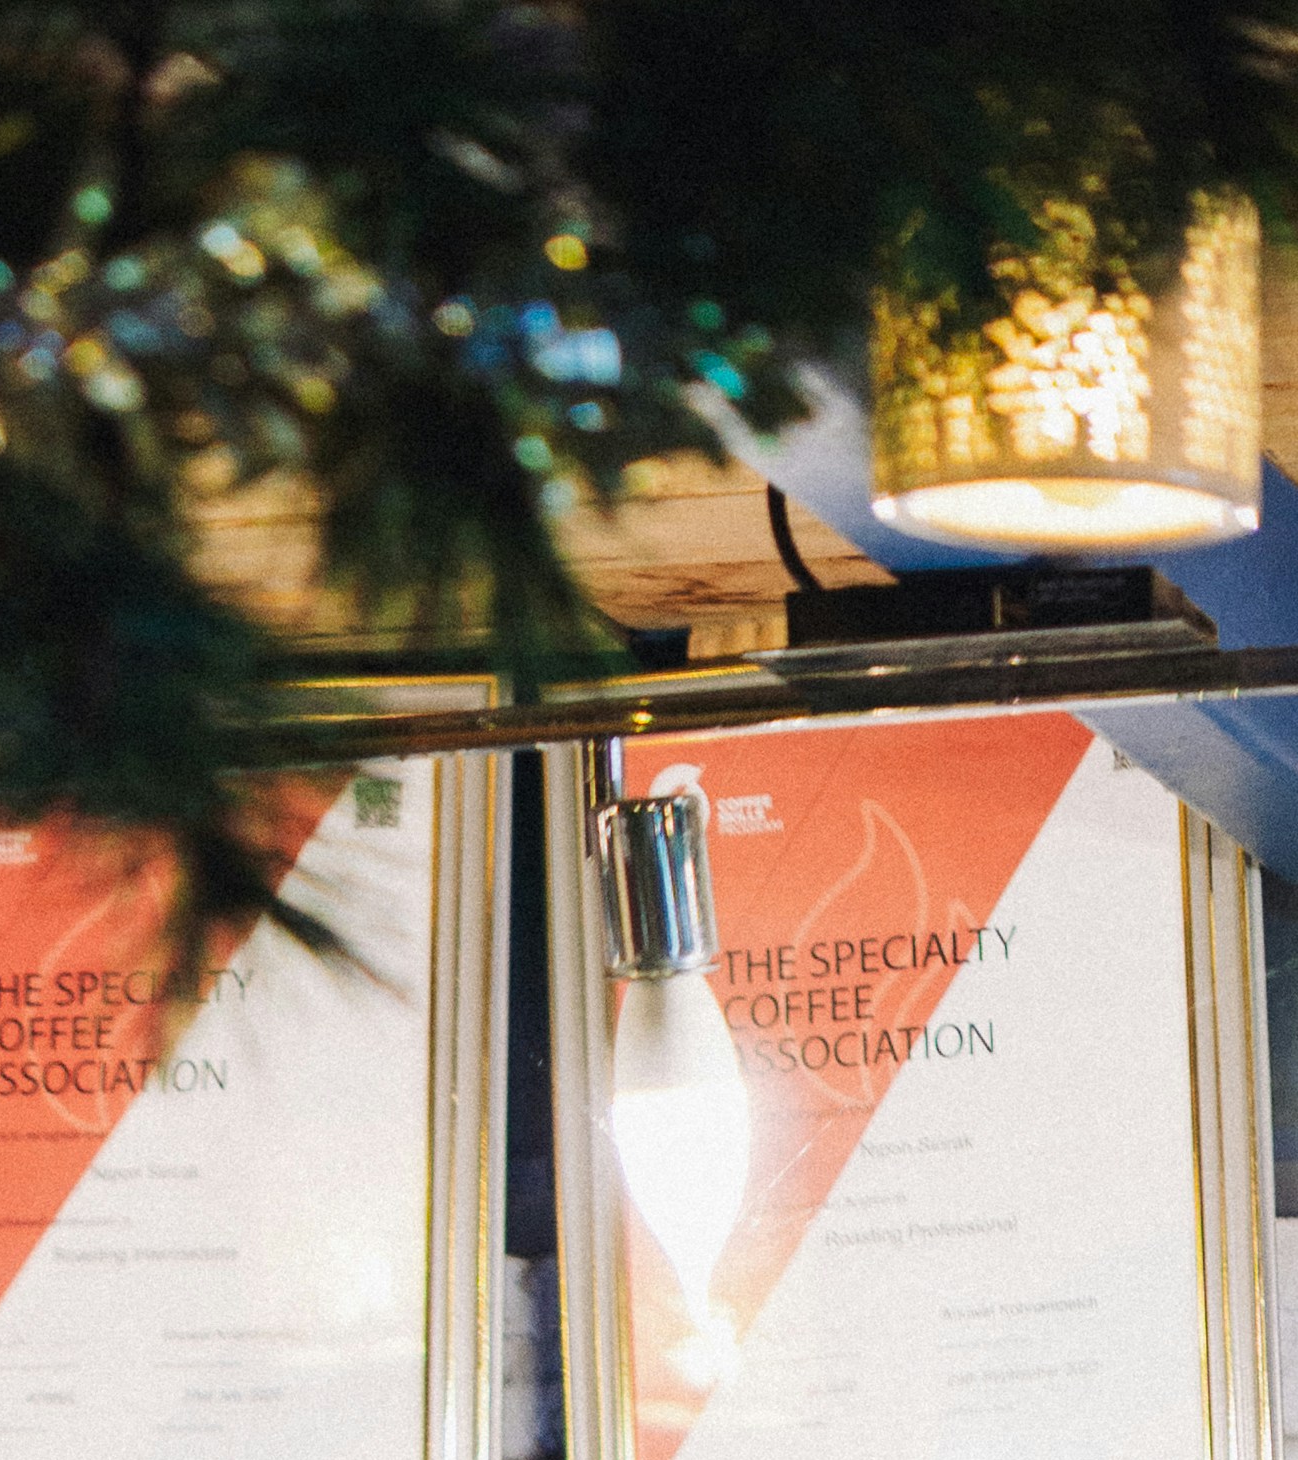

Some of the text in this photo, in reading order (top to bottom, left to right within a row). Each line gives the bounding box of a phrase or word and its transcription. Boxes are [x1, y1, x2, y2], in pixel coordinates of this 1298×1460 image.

[726, 926, 1016, 985] THE SPECIALTY
[55, 967, 255, 1007] SPECTY
[723, 985, 875, 1031] COFFEE
